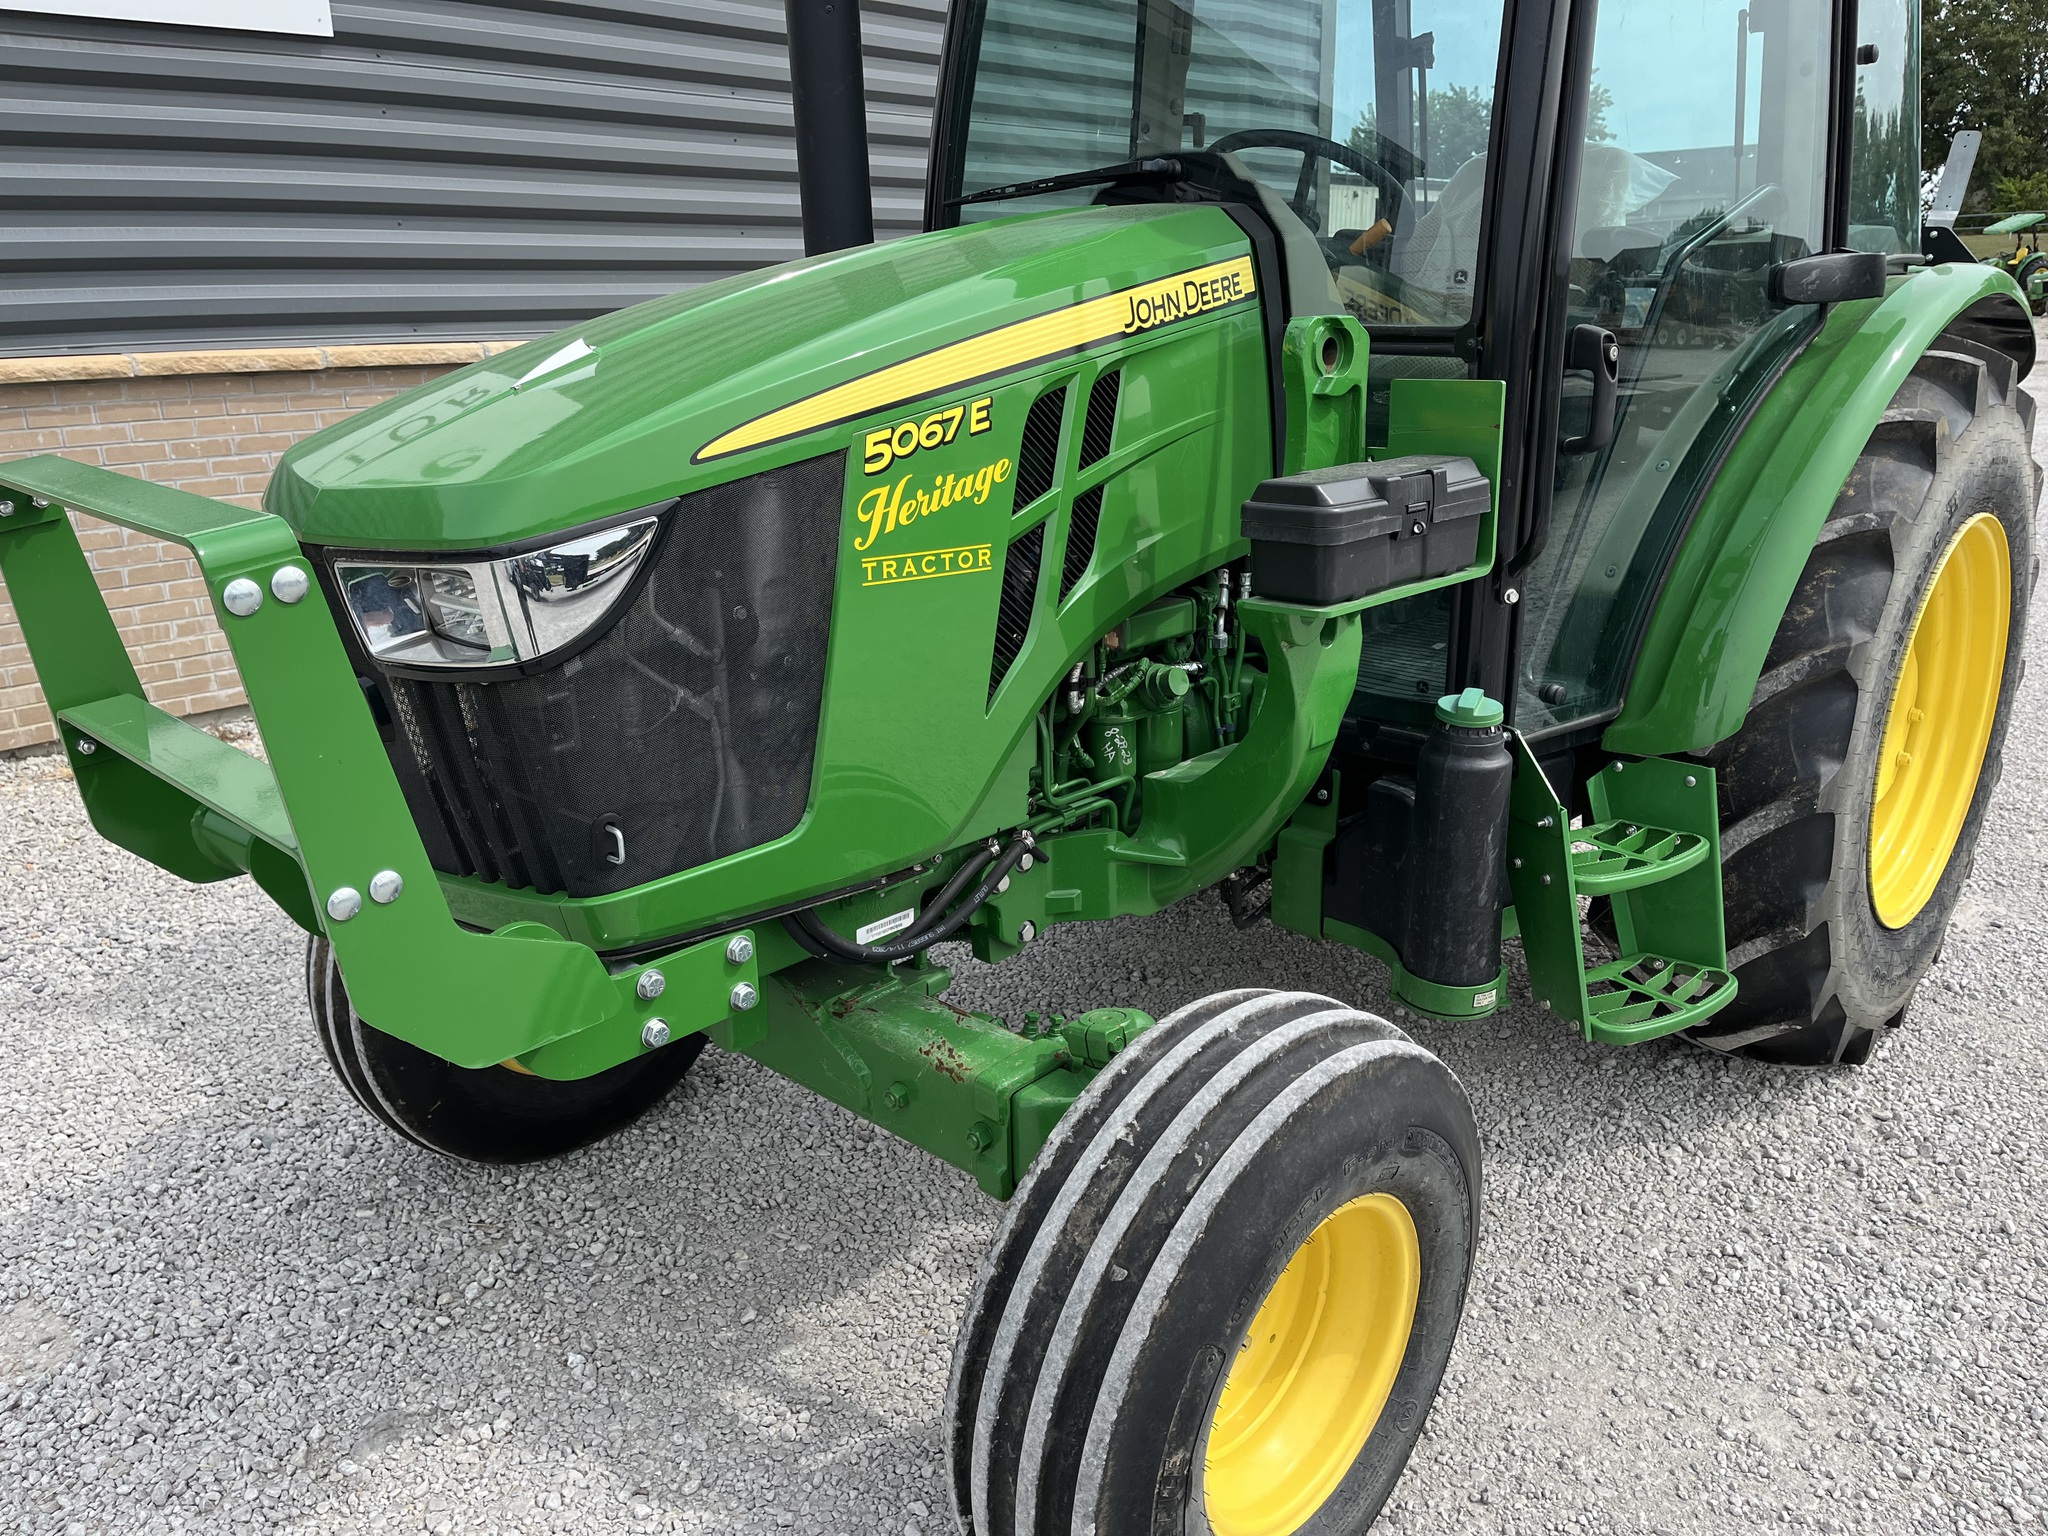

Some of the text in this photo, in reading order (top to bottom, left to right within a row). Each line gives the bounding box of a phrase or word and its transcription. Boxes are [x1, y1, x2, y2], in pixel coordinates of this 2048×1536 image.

[1124, 272, 1243, 330] JOHN DEERE
[854, 458, 1012, 551] Heritage
[862, 549, 991, 581] TRACTOR
